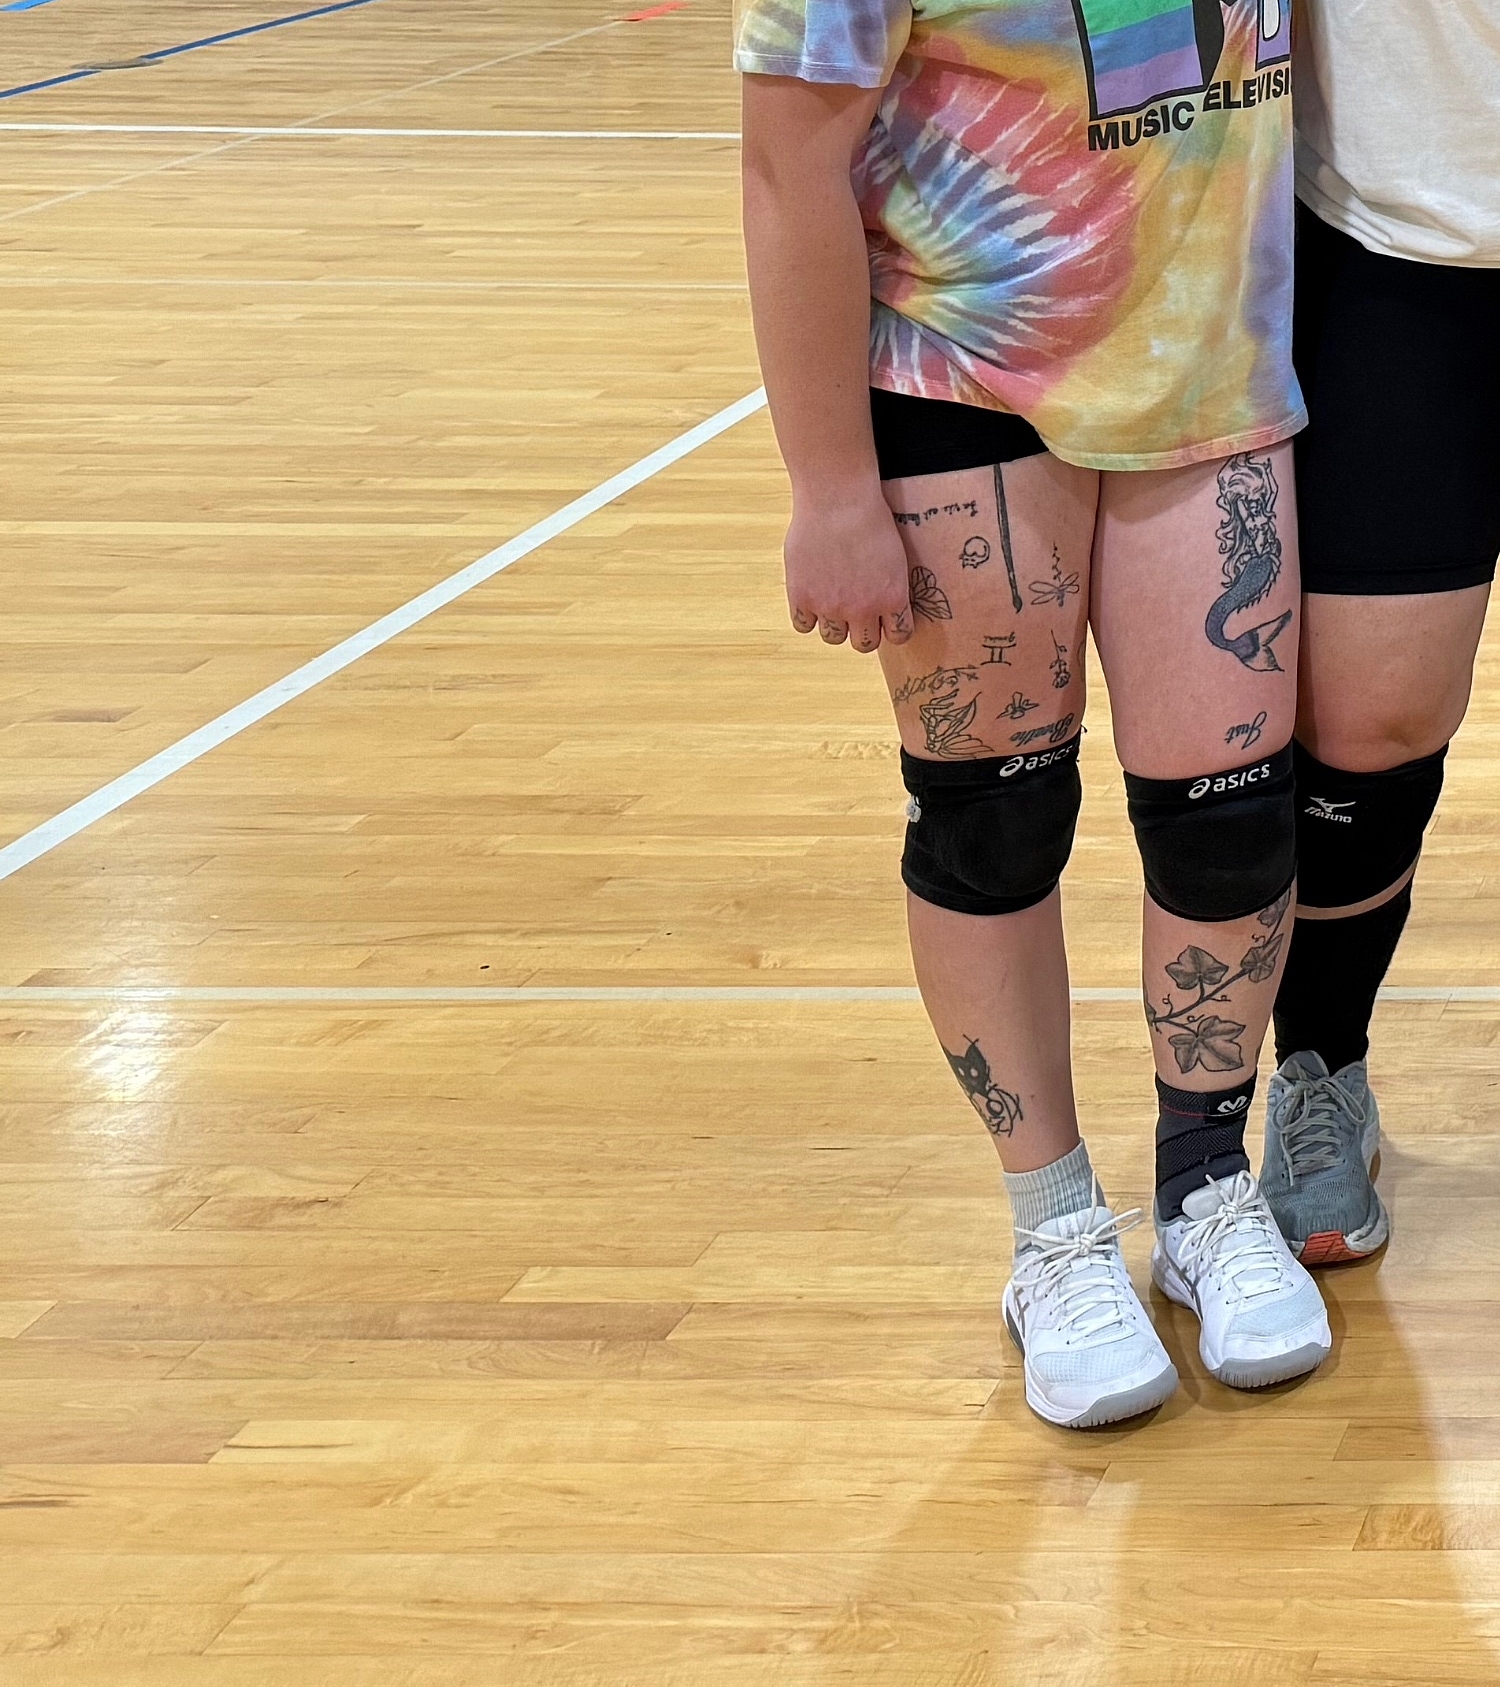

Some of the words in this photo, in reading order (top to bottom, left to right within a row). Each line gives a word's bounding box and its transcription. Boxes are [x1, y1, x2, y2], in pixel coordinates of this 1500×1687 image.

[1087, 101, 1195, 151] MUSIC
[1224, 711, 1267, 750] Just
[1025, 745, 1073, 770] asics
[1213, 763, 1271, 793] asics
